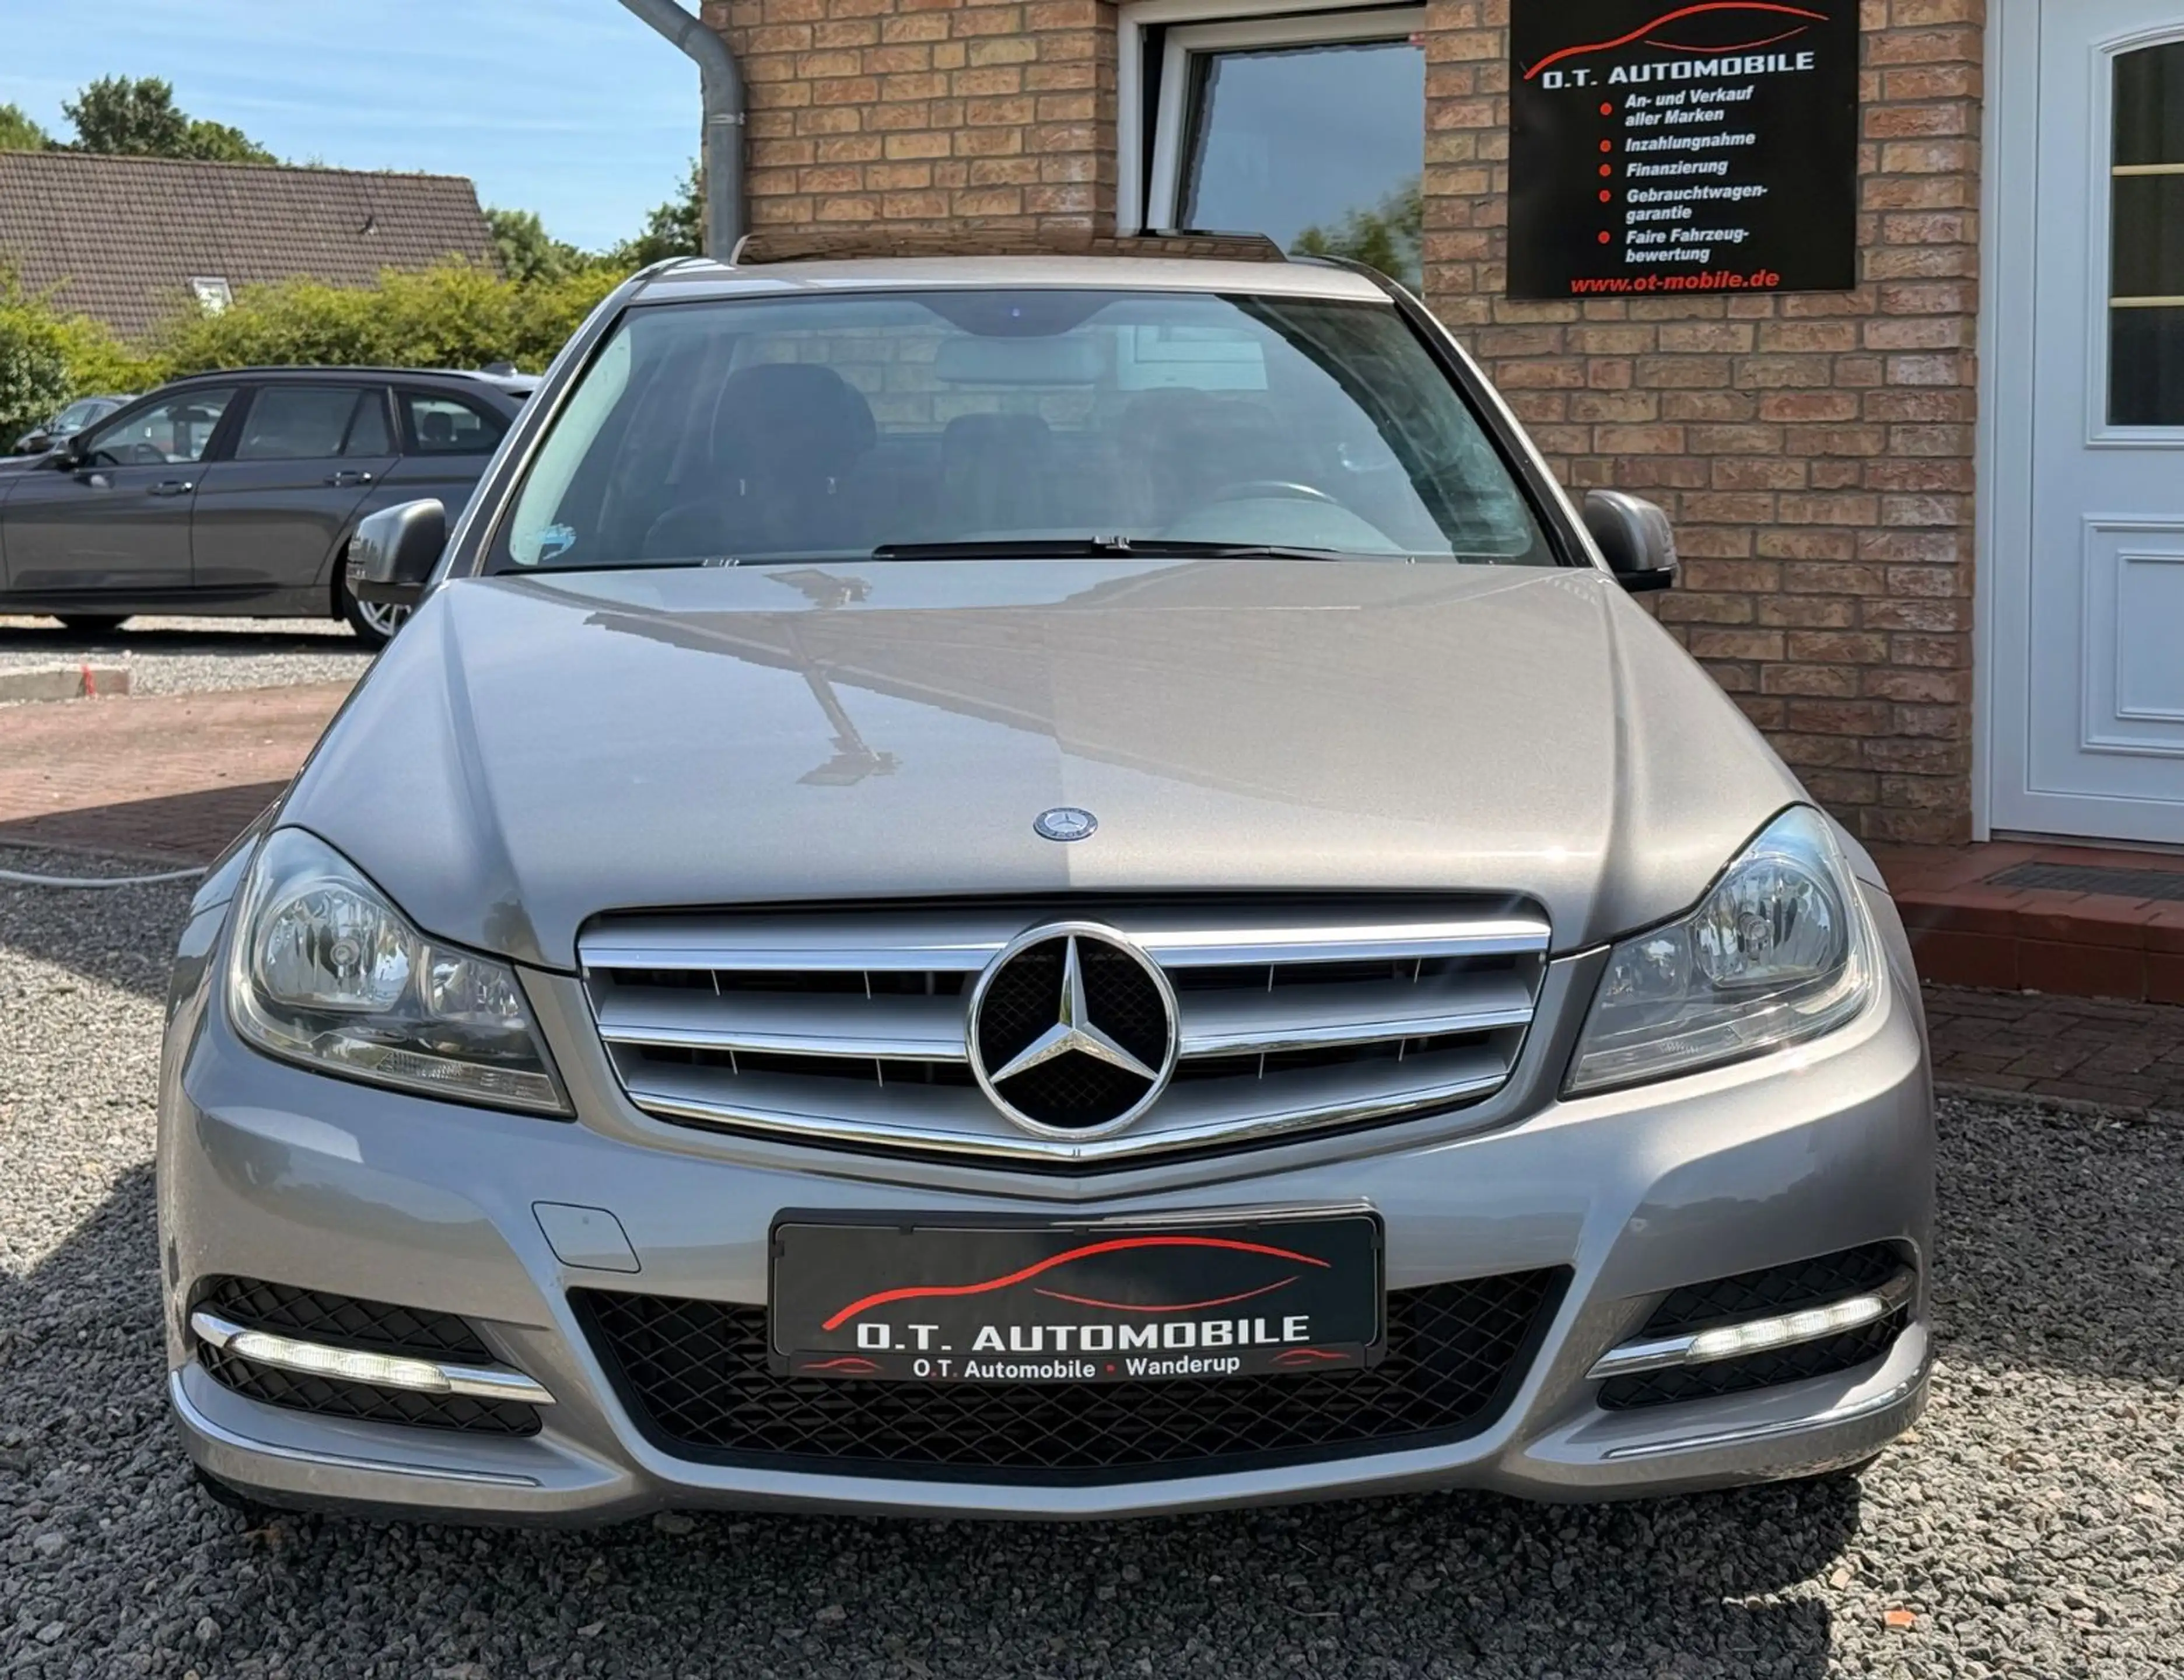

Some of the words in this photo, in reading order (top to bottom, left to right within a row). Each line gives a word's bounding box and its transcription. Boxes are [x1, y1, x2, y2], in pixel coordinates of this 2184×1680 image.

[1543, 69, 1598, 89] O.T.
[1608, 52, 1815, 84] AUTOMOBILE
[1625, 93, 1651, 108] An-
[1656, 90, 1686, 106] und
[1690, 85, 1755, 103] Verkauf
[1625, 111, 1661, 127] aller
[1664, 108, 1724, 124] Marken
[1625, 131, 1756, 152] Inzahlungnahme
[1626, 160, 1728, 177] Finanzierung
[1627, 184, 1768, 202] Gebrauchtwagen-
[1625, 205, 1692, 225] garantie
[1625, 230, 1666, 244] Faire
[1670, 227, 1749, 243] Fahrzeug-
[1625, 248, 1711, 263] bewertung
[1571, 269, 1780, 292] www.ot-mobile.de
[858, 1323, 951, 1350] O.T.
[972, 1315, 1310, 1351] AUTOMOBILE
[964, 1360, 1096, 1378] Automobile
[1125, 1355, 1240, 1374] Wanderup
